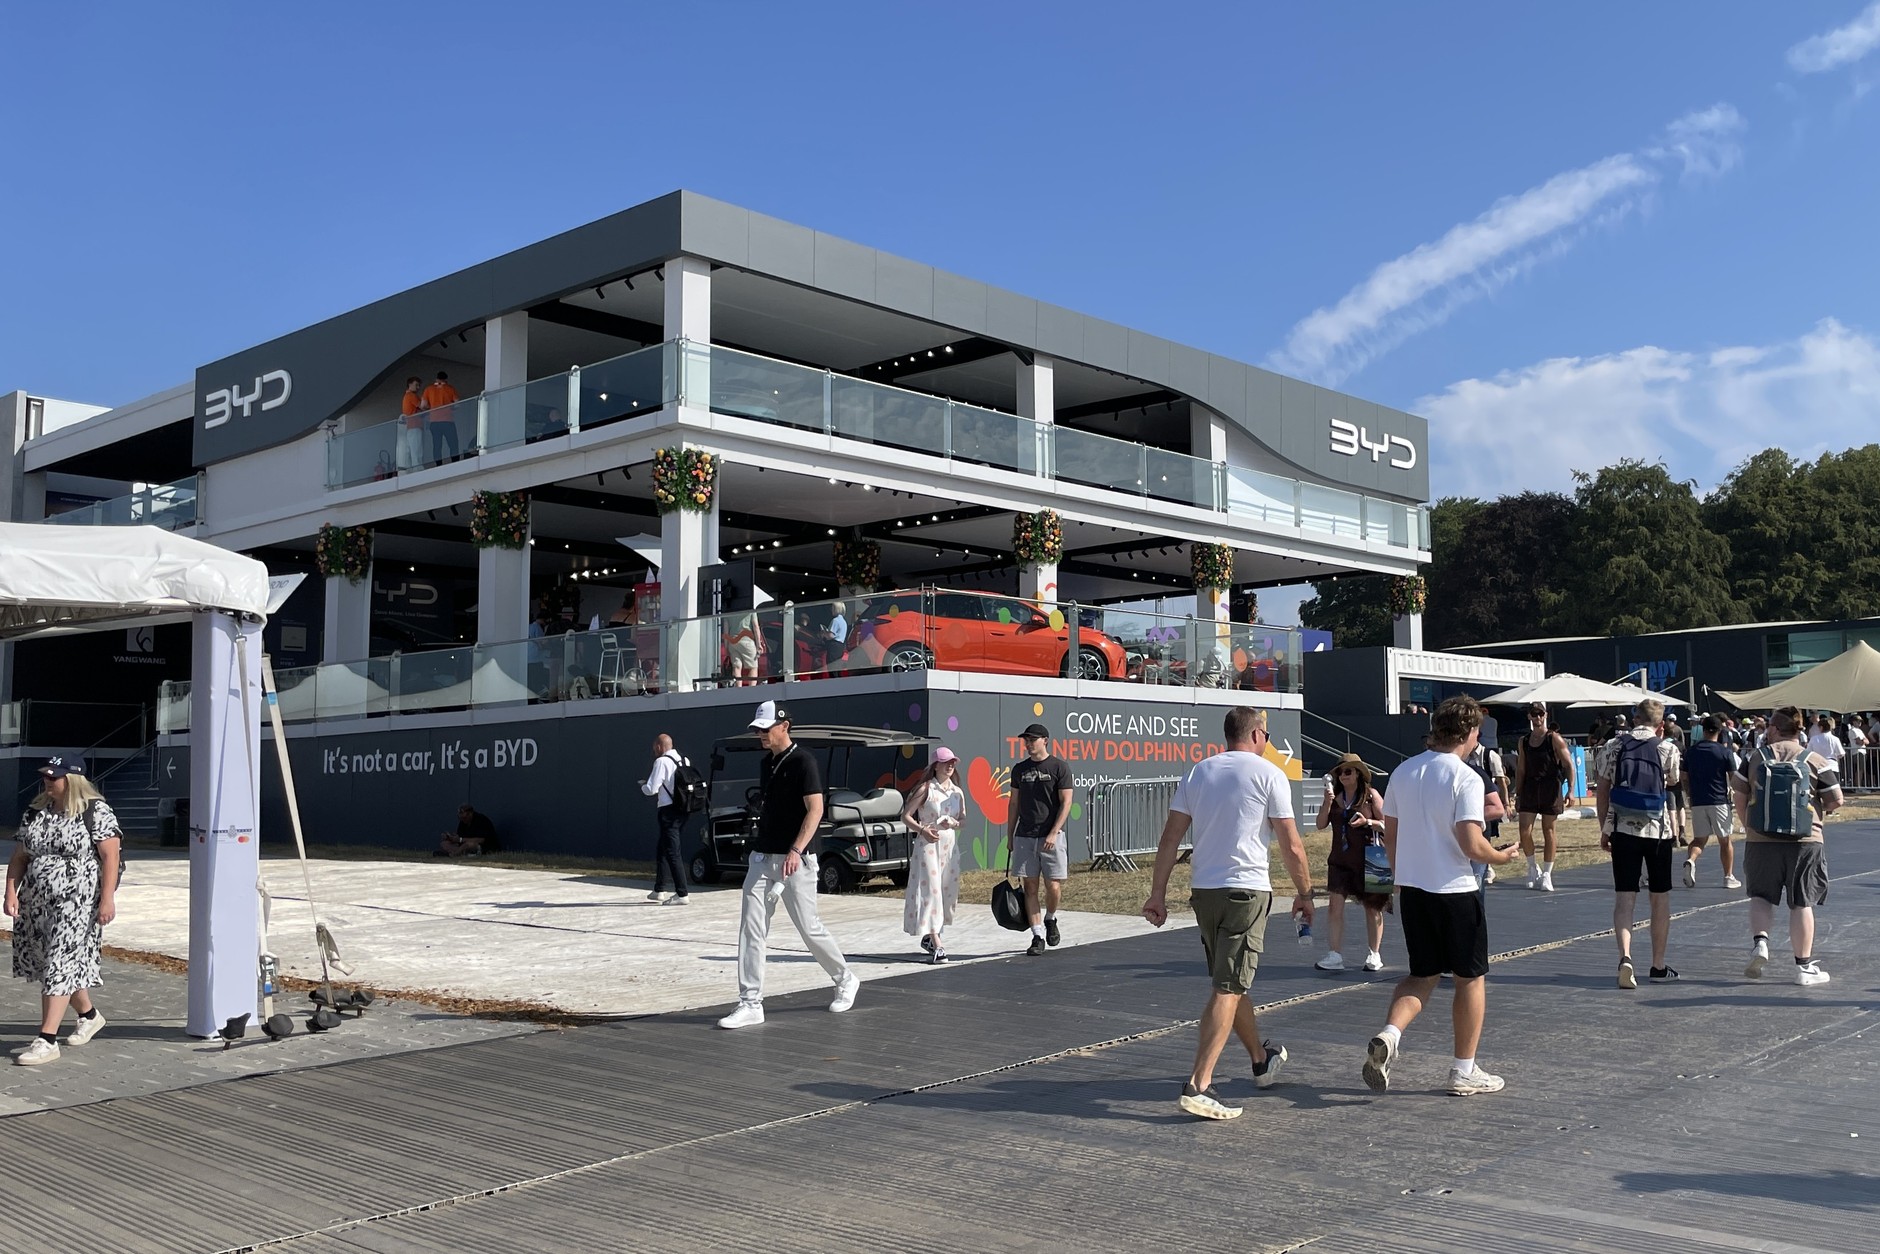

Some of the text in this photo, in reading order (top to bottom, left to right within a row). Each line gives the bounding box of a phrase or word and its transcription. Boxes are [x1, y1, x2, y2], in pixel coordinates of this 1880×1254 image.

[205, 369, 292, 429] BYD
[1330, 418, 1416, 469] BYD
[374, 580, 438, 604] YD
[113, 656, 166, 664] YANGWANG
[1066, 712, 1199, 738] COME AND SEE
[352, 749, 382, 773] not
[385, 753, 397, 772] a
[402, 751, 435, 775] car,
[474, 748, 488, 768] a
[494, 738, 538, 767] BYD
[1053, 739, 1099, 761] NEW
[1105, 741, 1186, 763] DOLPHIN
[1189, 743, 1202, 763] G
[1072, 774, 1097, 788] lobal
